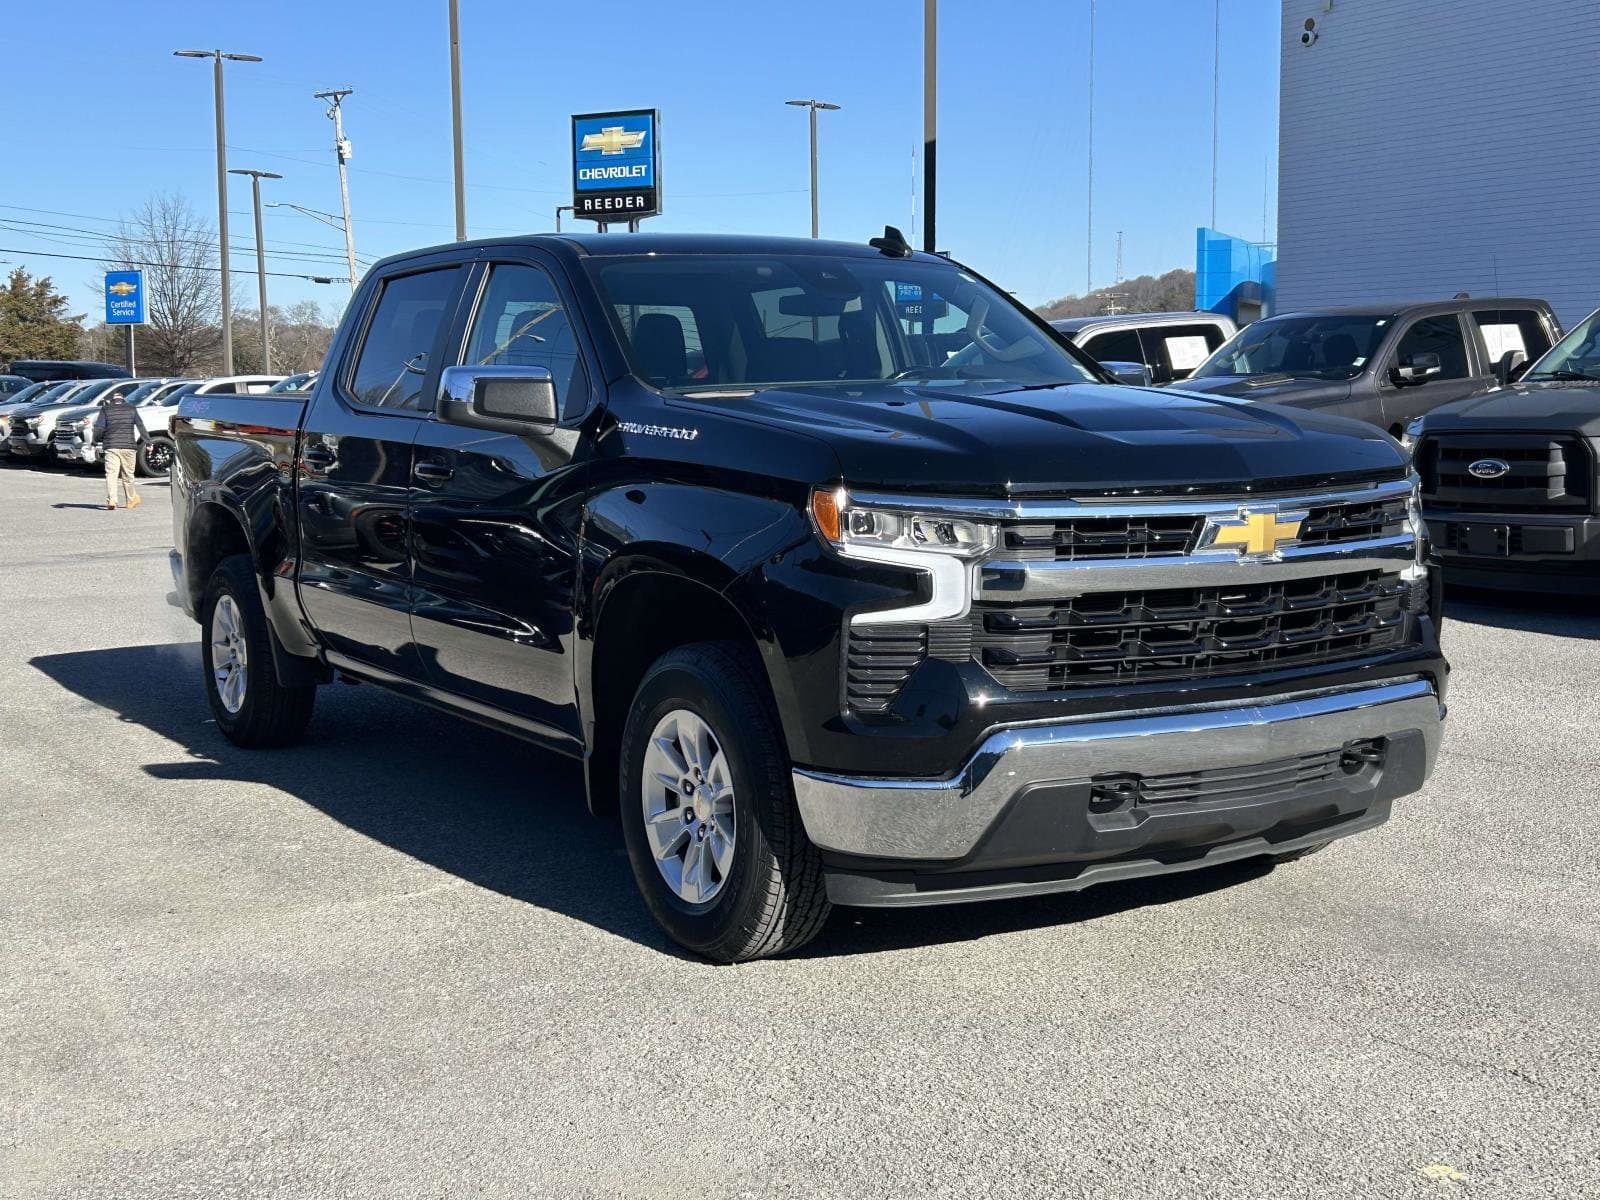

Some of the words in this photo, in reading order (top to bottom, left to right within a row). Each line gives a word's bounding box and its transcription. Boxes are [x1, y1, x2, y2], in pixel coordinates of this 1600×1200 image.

[579, 165, 647, 180] CHEVROLET
[584, 196, 644, 210] REEDER
[110, 300, 136, 308] Certified
[112, 308, 135, 317] Service
